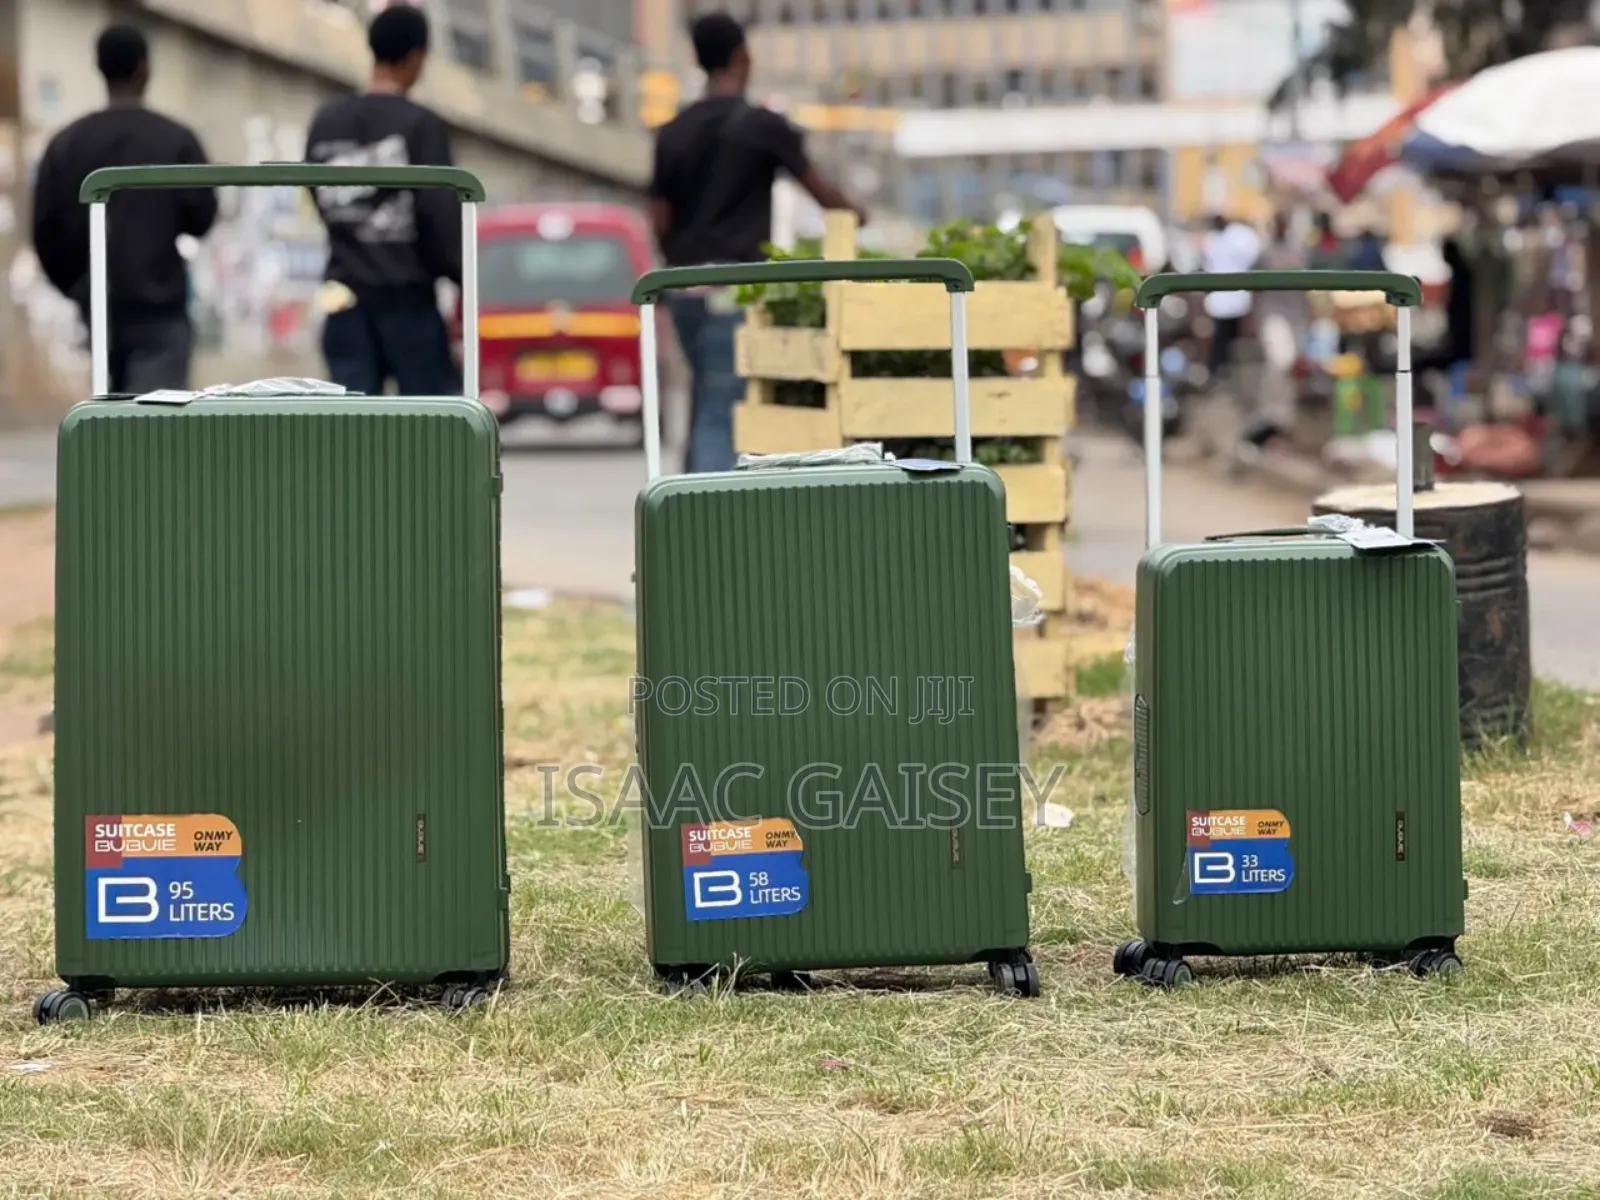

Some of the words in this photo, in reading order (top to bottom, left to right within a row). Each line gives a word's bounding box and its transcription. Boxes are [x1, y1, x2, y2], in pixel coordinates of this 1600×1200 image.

[1192, 816, 1246, 826] SUITCASE
[95, 824, 176, 837] SUITCASE
[194, 830, 233, 841] ONMY
[689, 827, 751, 842] SUITCASE
[194, 842, 223, 852] WAY
[1241, 855, 1258, 868] 33
[749, 872, 769, 887] 58
[1242, 869, 1286, 882] LITERS
[169, 881, 194, 900] 95
[750, 887, 801, 905] LITERS
[169, 904, 235, 922] LITERS
